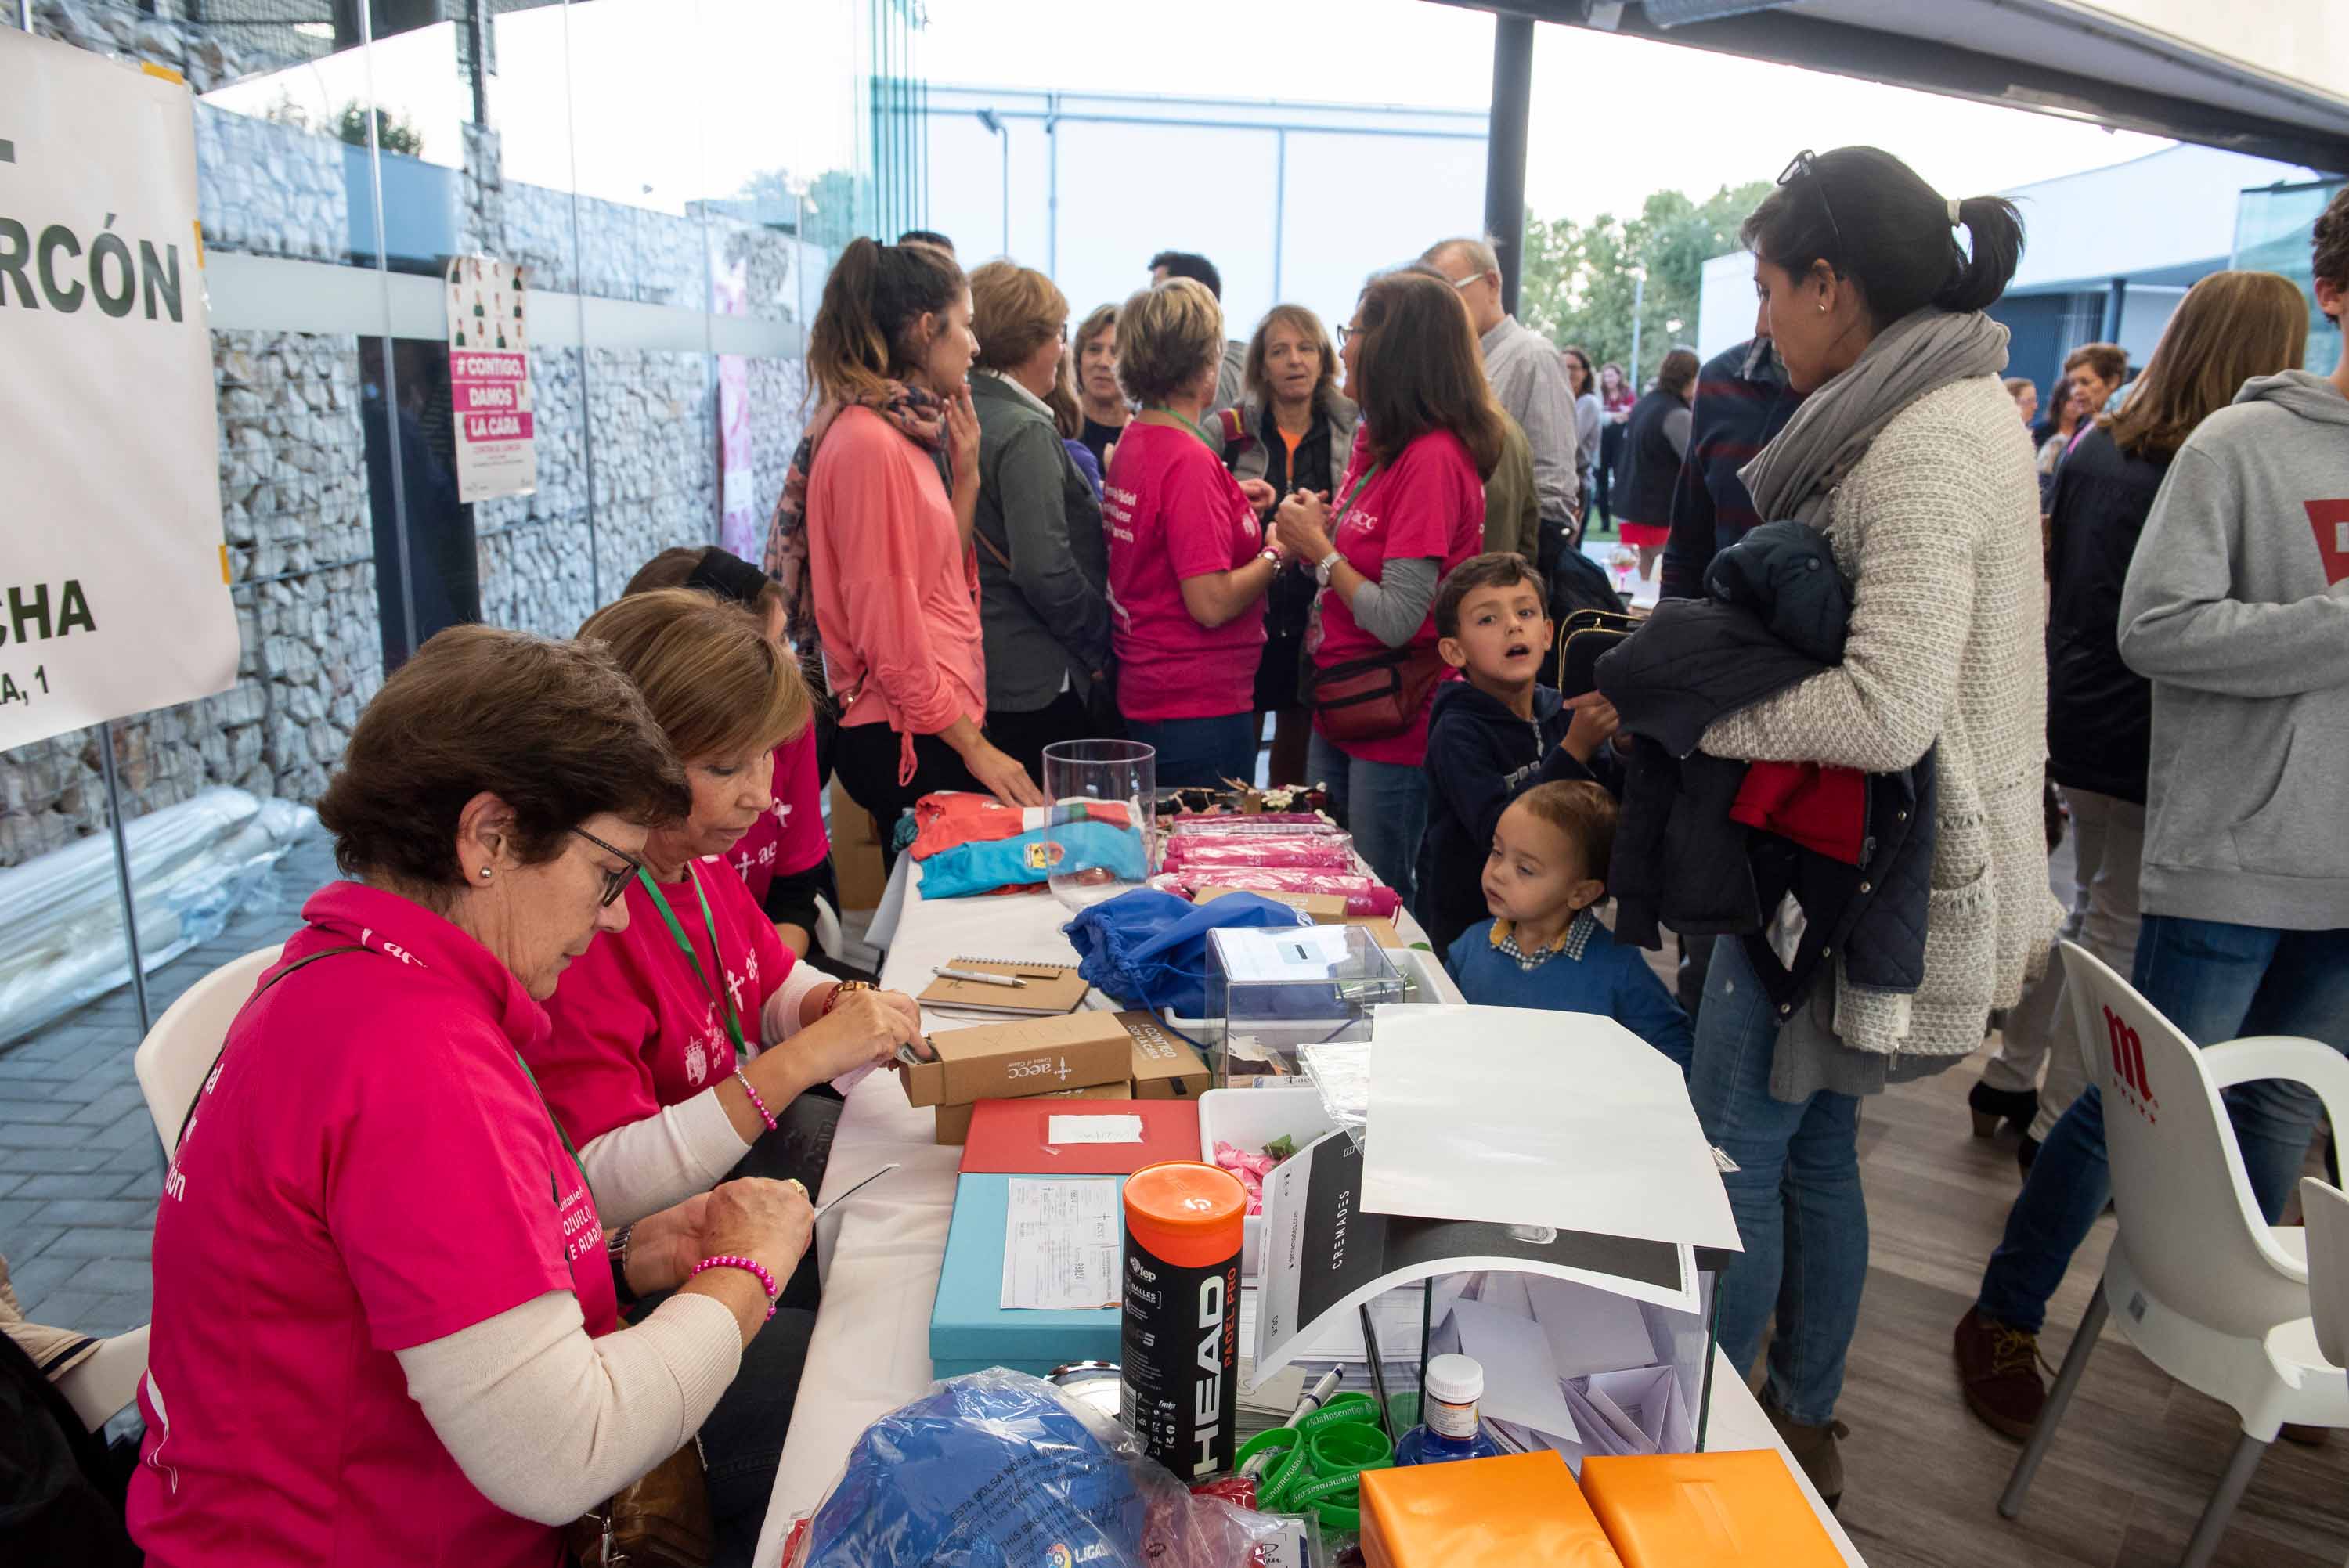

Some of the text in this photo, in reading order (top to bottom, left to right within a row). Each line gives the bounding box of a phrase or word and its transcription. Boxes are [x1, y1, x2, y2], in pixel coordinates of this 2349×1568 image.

[467, 357, 524, 379] CONTIGO,
[468, 387, 514, 407] DAMOS
[470, 416, 521, 438] LA CARA
[1145, 1027, 1177, 1058] CONTIGO
[1008, 1063, 1052, 1080] aecc
[563, 1205, 593, 1237] OZUELO
[1331, 1189, 1350, 1271] CREMADES
[569, 1243, 578, 1260] E
[1224, 1267, 1236, 1368] PADEL PRO
[1193, 1275, 1225, 1476] HEAD
[972, 1473, 1005, 1503] BOLSA
[1000, 1531, 1023, 1552] THIS
[1021, 1514, 1041, 1534] BAG
